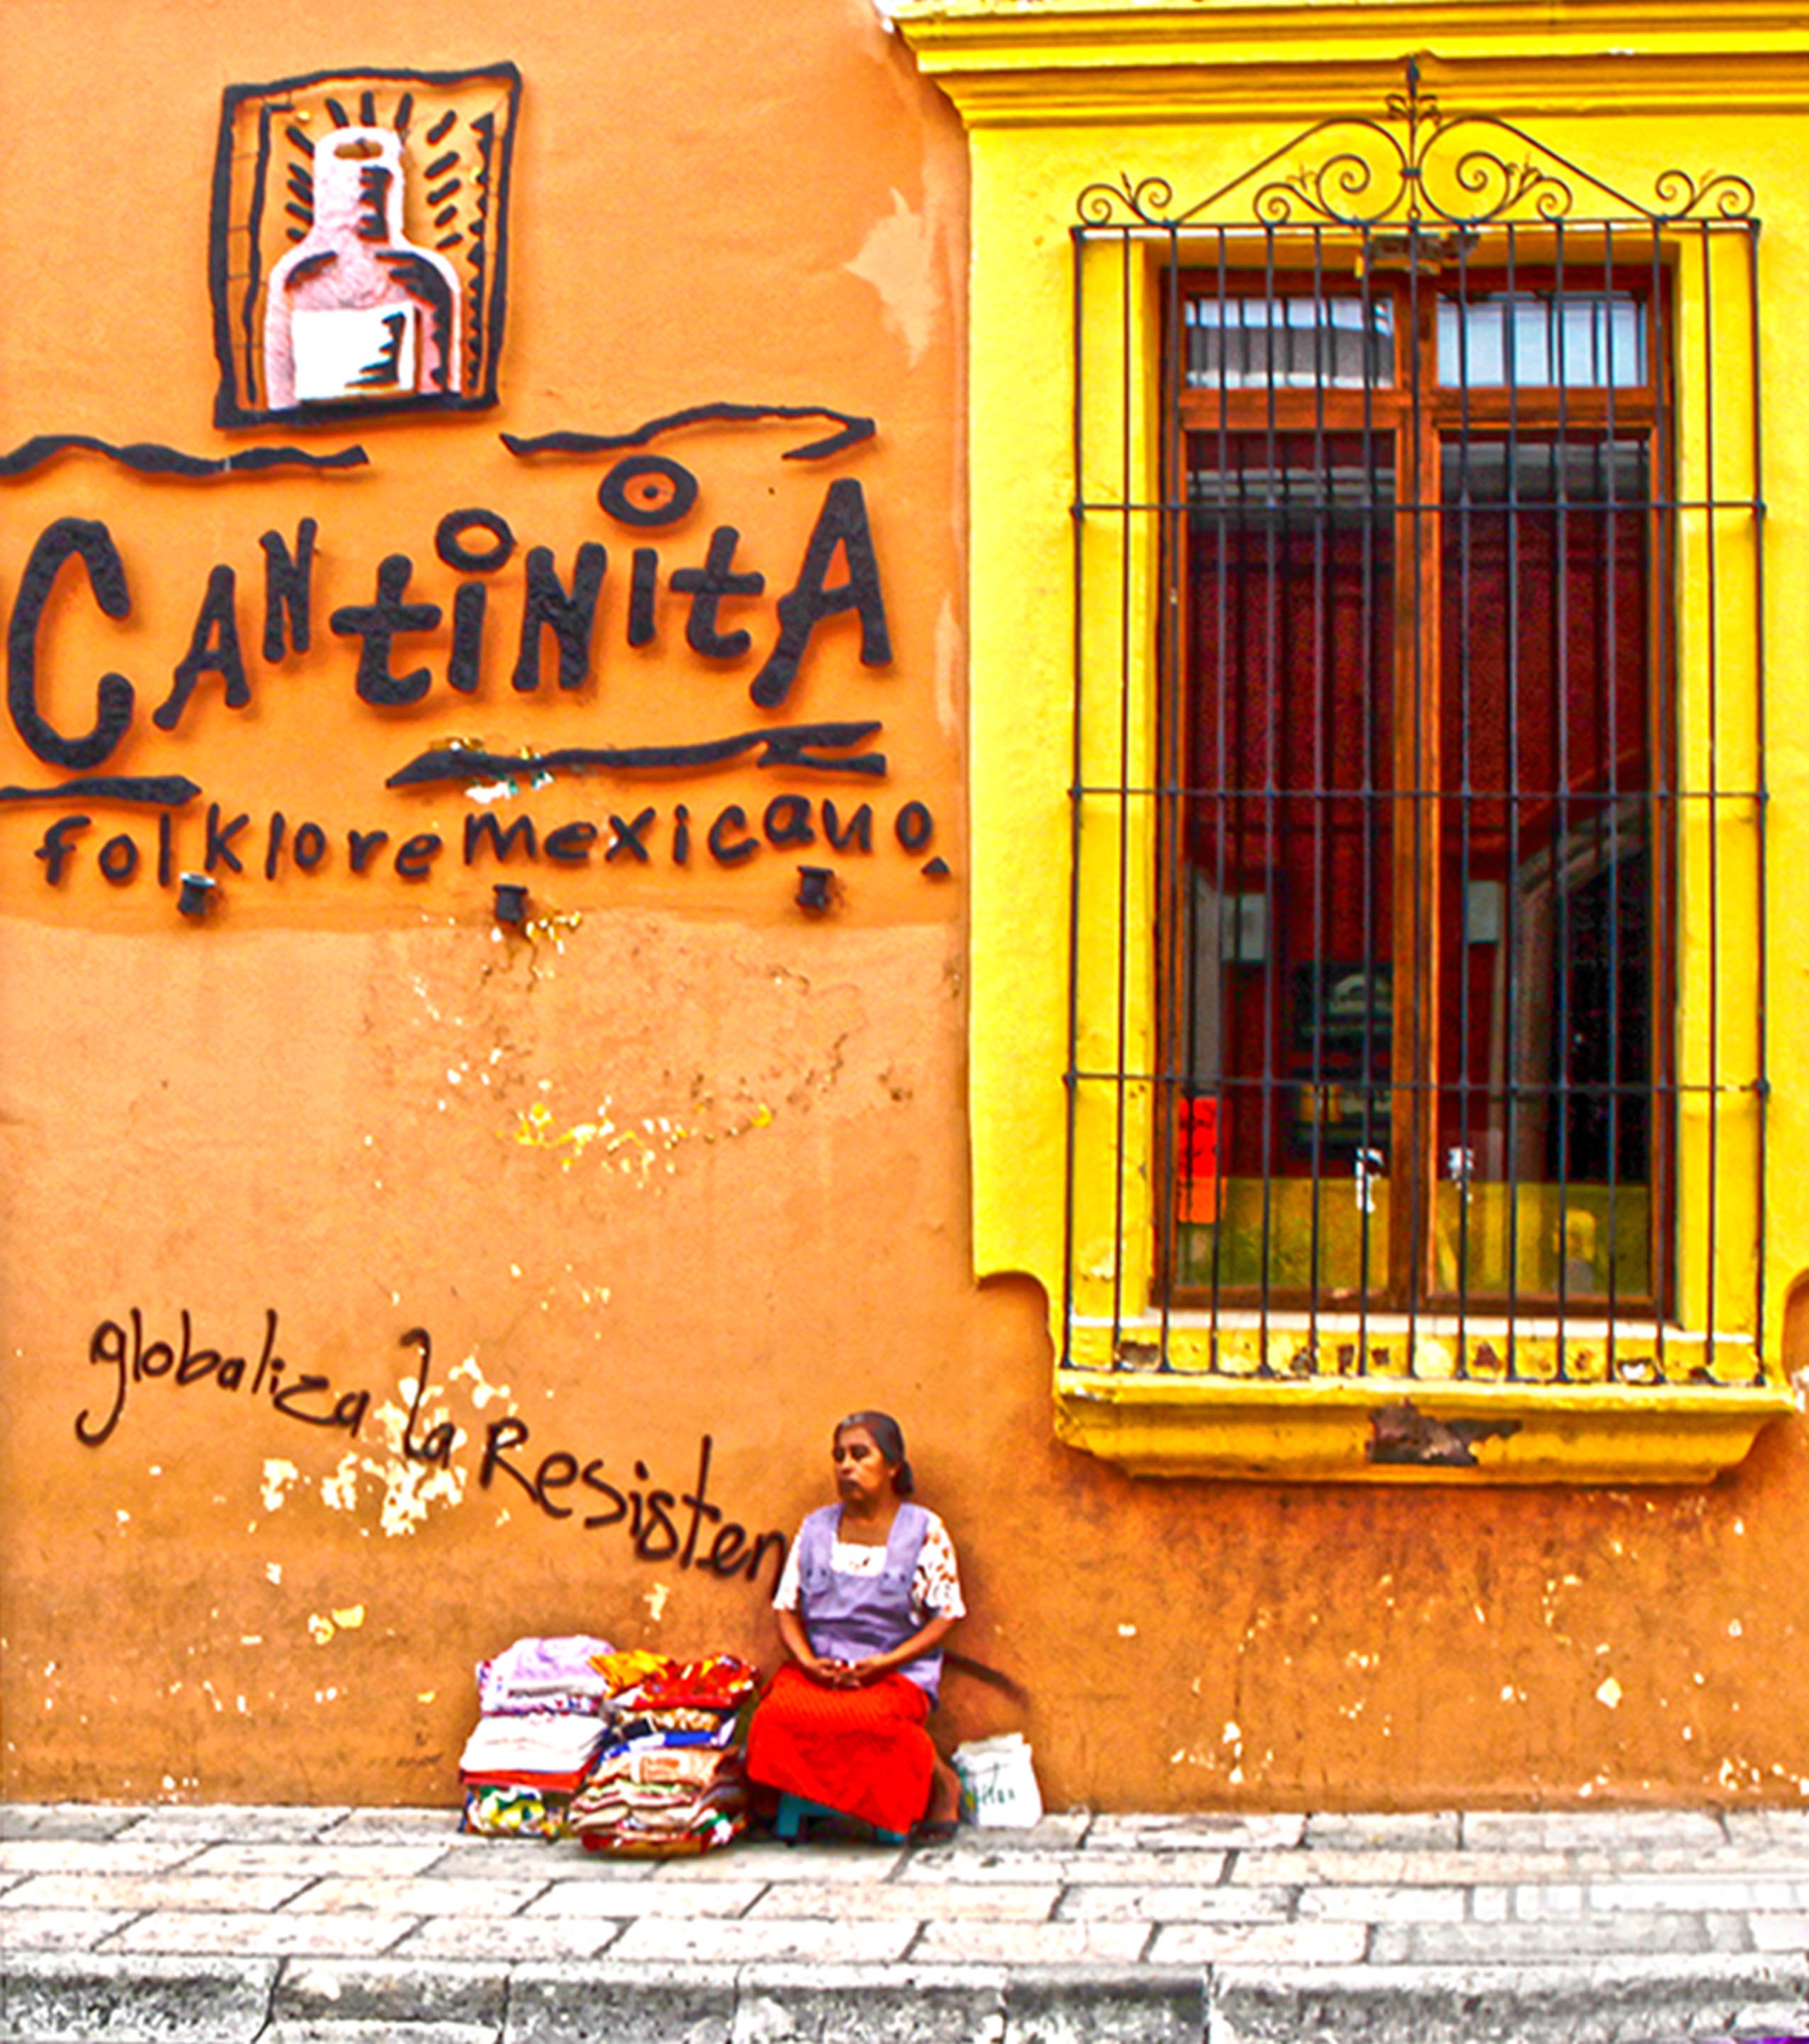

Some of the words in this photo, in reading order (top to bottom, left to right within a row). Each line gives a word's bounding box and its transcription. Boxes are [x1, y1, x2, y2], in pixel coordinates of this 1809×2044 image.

[35, 803, 443, 886] folklore
[75, 1308, 371, 1447] globaliza
[399, 1328, 456, 1472] la
